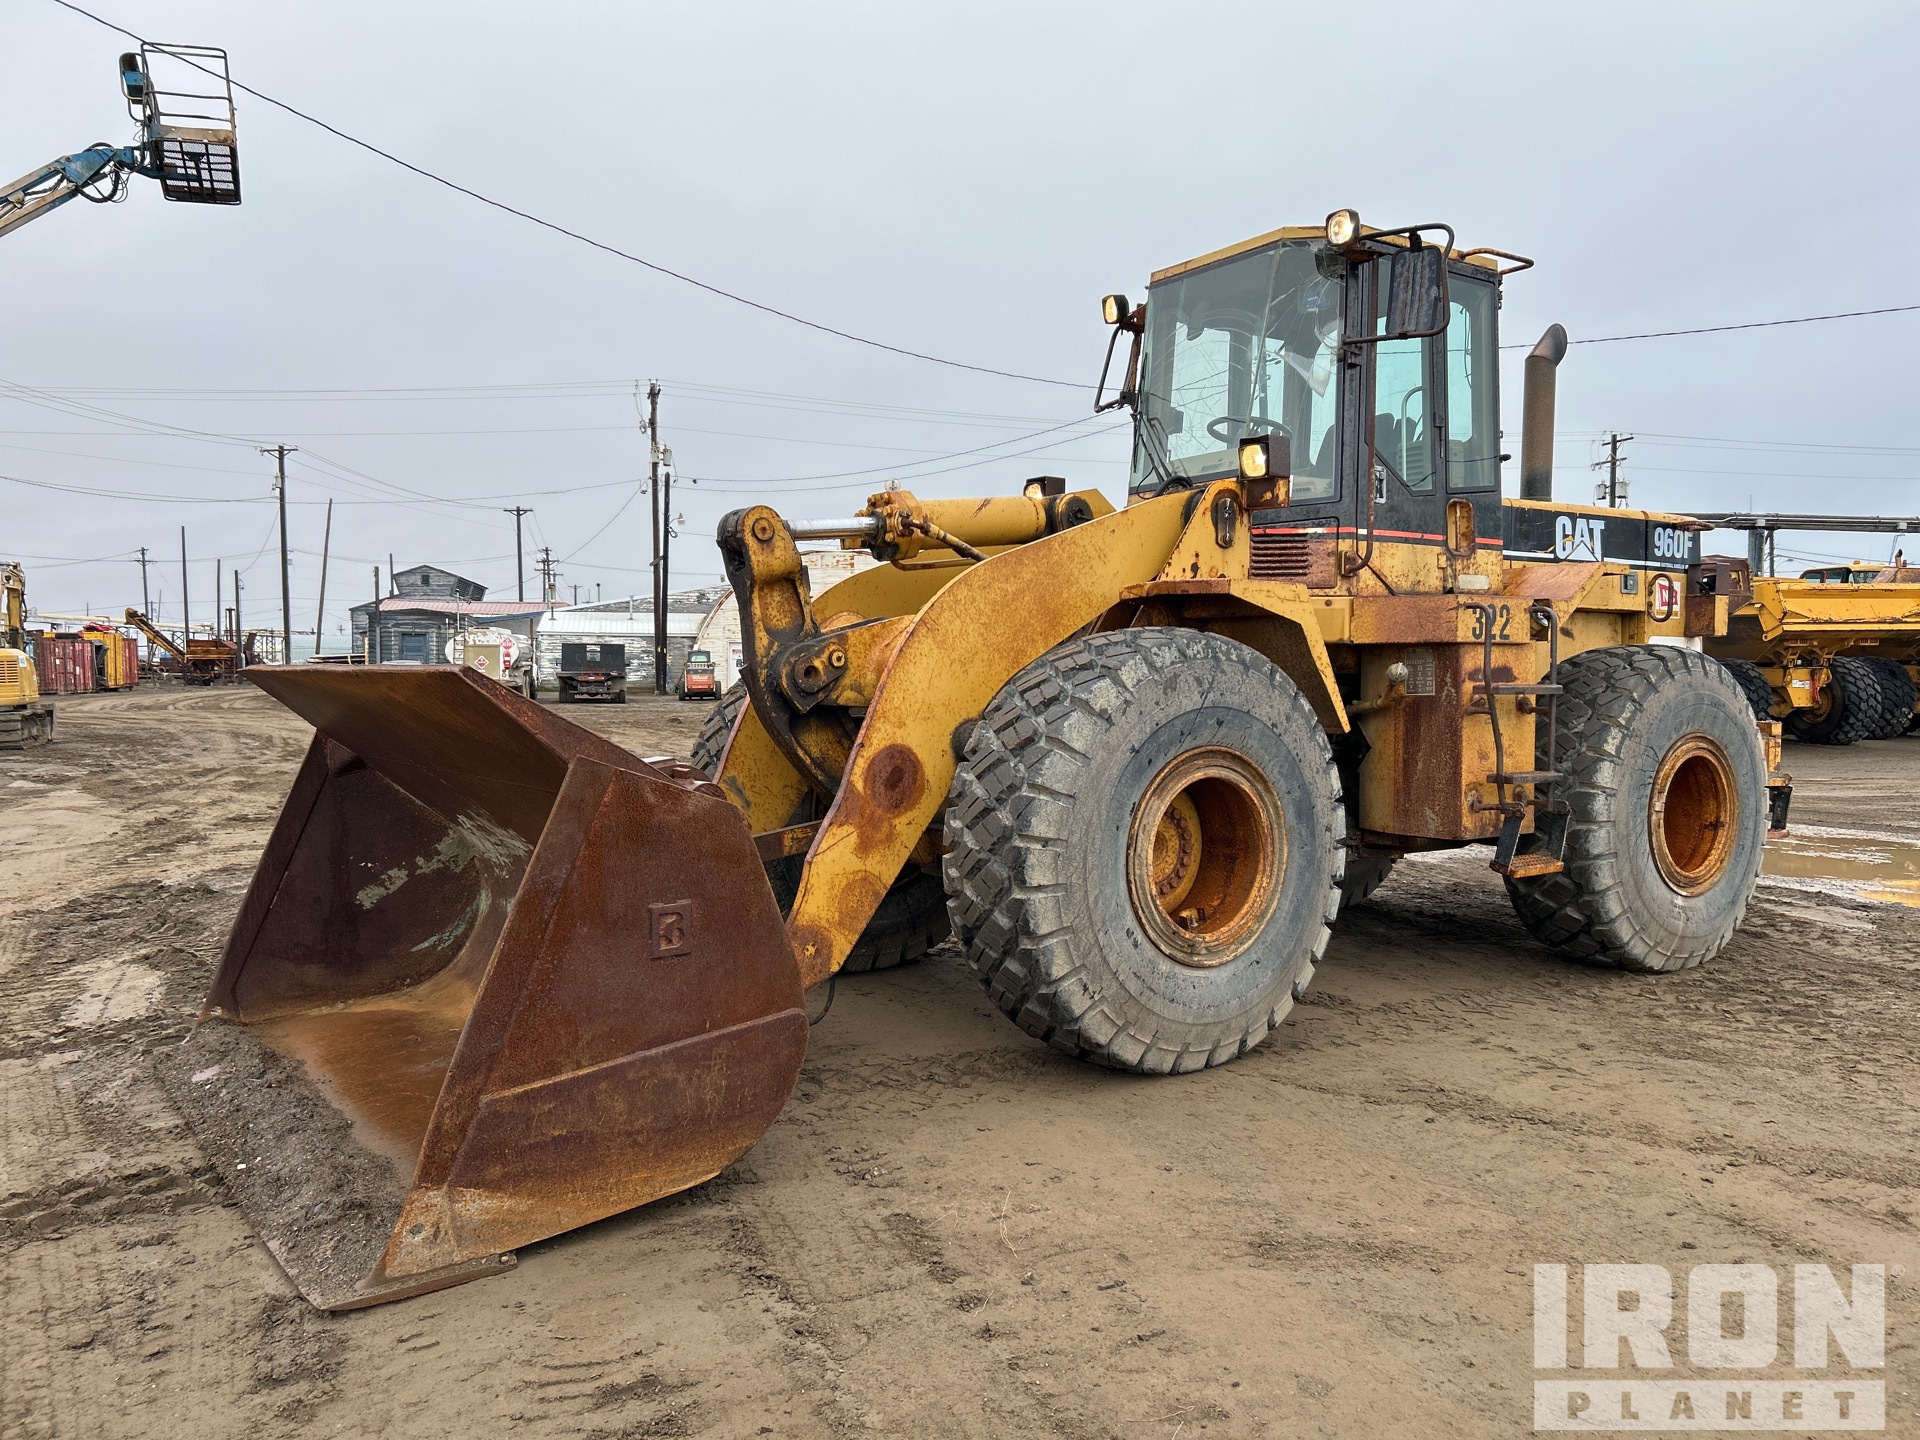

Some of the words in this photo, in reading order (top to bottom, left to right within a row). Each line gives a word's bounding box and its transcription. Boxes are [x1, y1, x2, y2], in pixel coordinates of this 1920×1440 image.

[1555, 515, 1606, 562] CAT
[1654, 527, 1693, 559] 960F
[1472, 604, 1510, 640] 322
